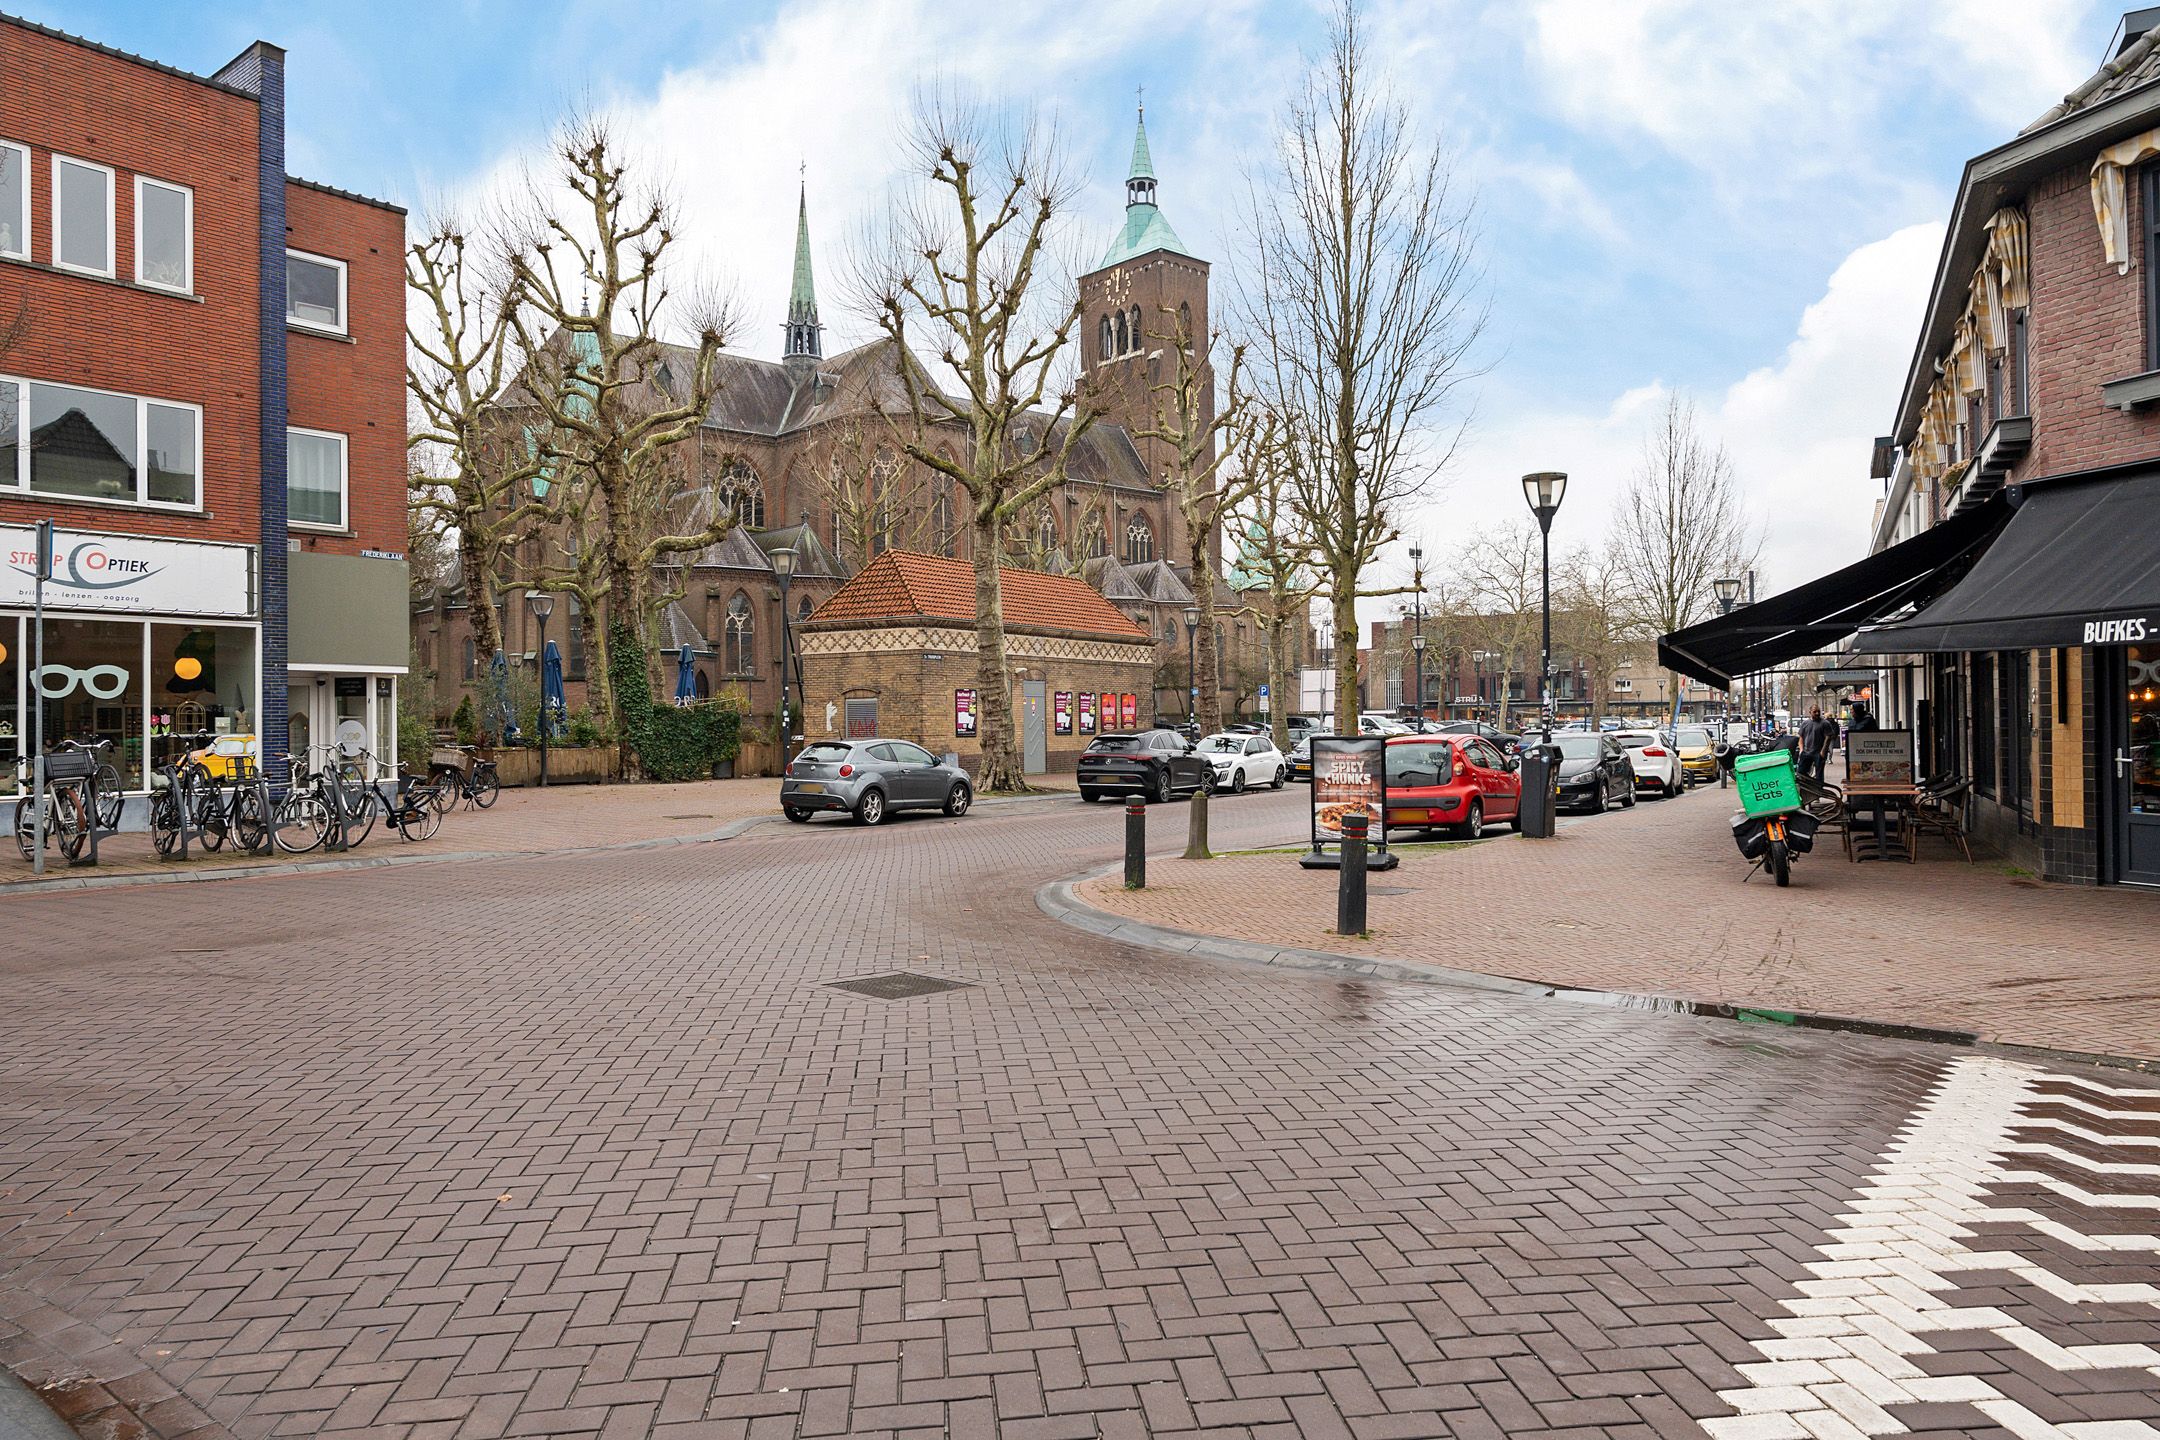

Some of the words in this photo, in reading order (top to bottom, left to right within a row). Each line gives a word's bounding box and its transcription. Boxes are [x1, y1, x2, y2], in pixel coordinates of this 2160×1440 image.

[362, 550, 403, 560] FREDERIKLAAN
[9, 550, 63, 567] STRP
[86, 551, 149, 573] OPTIEK
[18, 589, 50, 597] briln
[61, 591, 92, 599] lenzen
[103, 594, 140, 603] oogzorg
[2083, 618, 2147, 643] BUFKES
[1261, 686, 1267, 696] P
[1330, 760, 1365, 773] SPICY
[1324, 773, 1372, 785] CHUNKS
[1751, 780, 1779, 791] Uber
[1755, 790, 1783, 801] Eats
